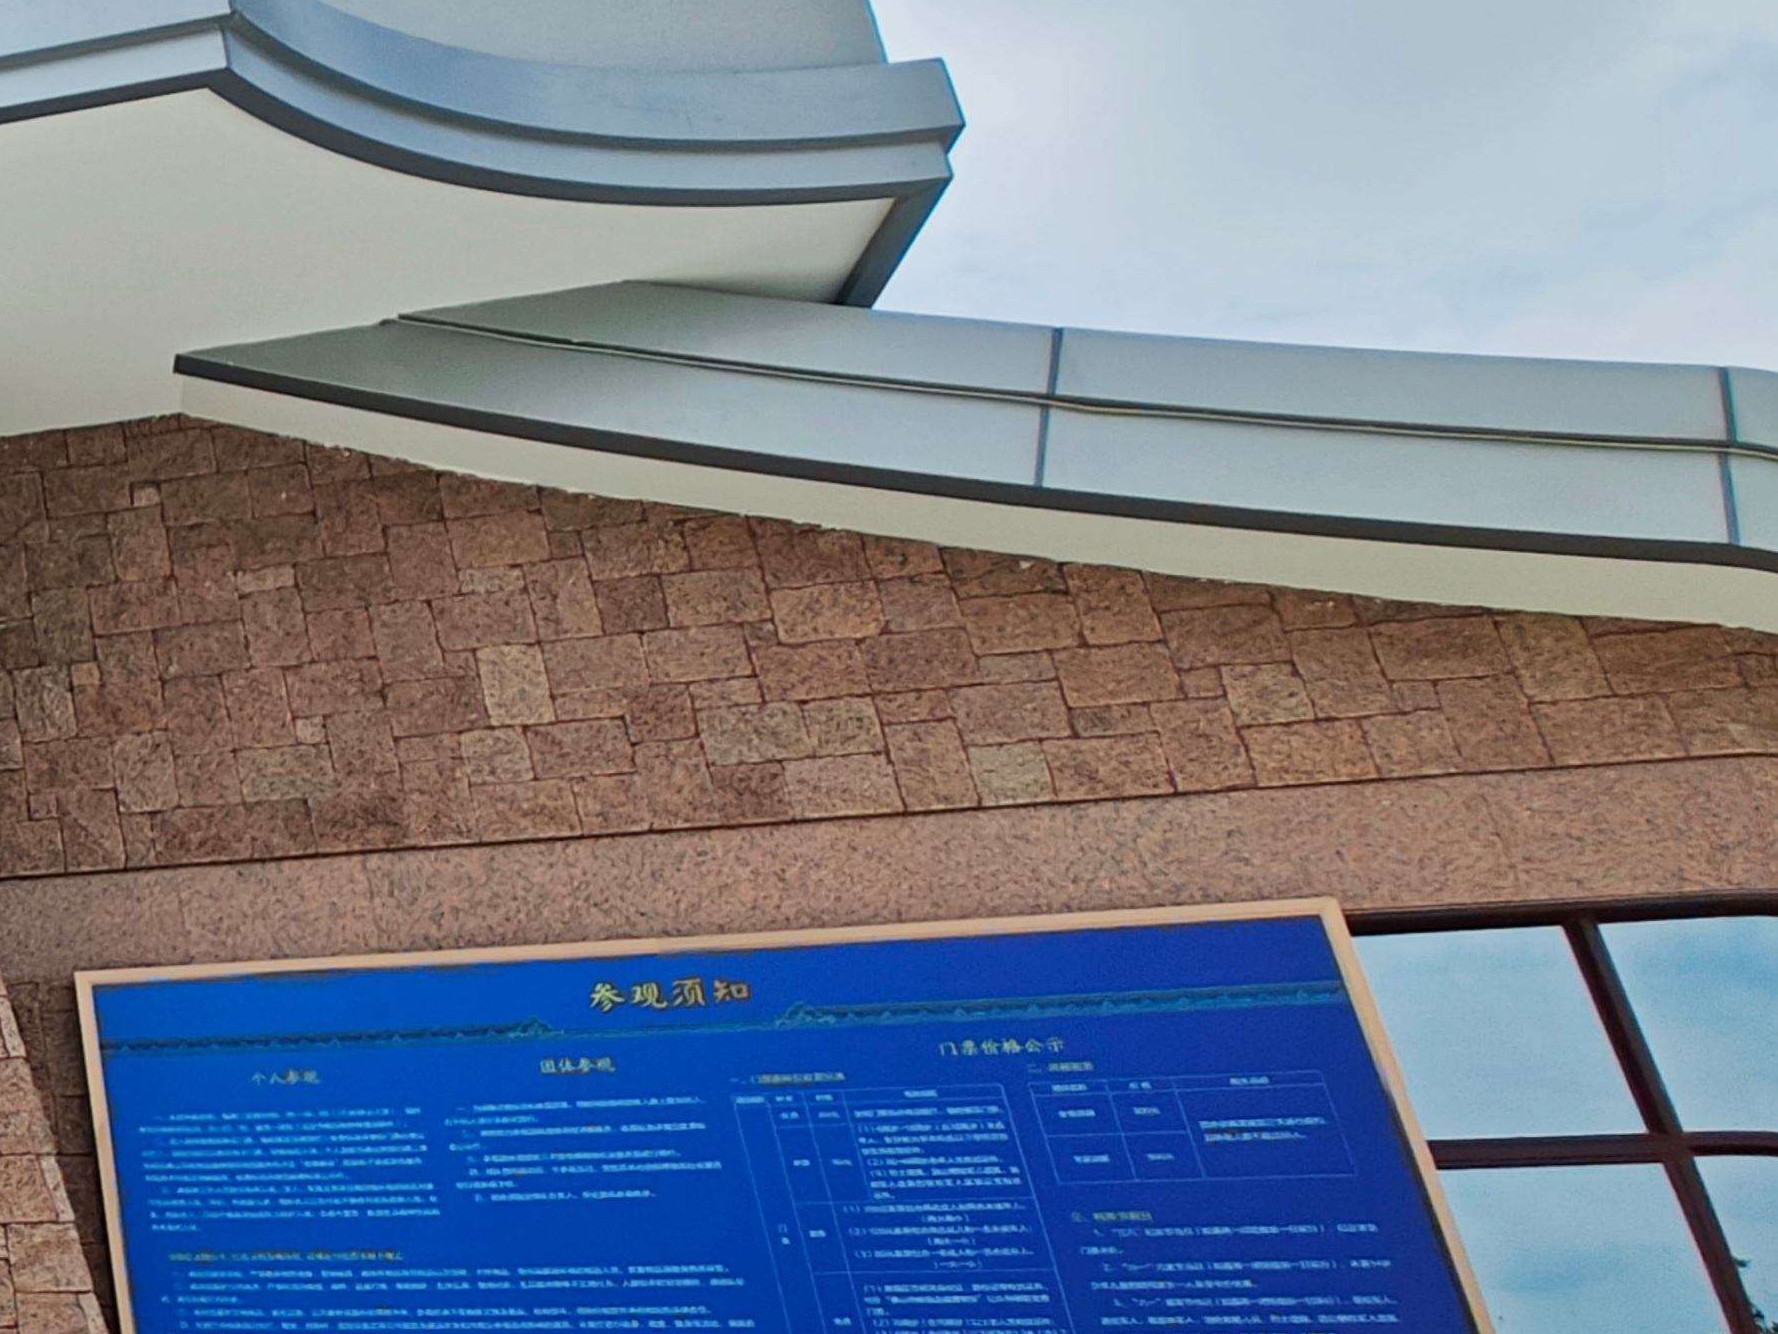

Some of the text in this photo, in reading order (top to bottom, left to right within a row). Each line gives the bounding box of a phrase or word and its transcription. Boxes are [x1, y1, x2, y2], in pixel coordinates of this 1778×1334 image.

[589, 978, 751, 1012] 参观须知
[939, 1037, 1064, 1056] 门票价格公示
[539, 1056, 616, 1074] 团体参观
[251, 1069, 321, 1085] 个人参观
